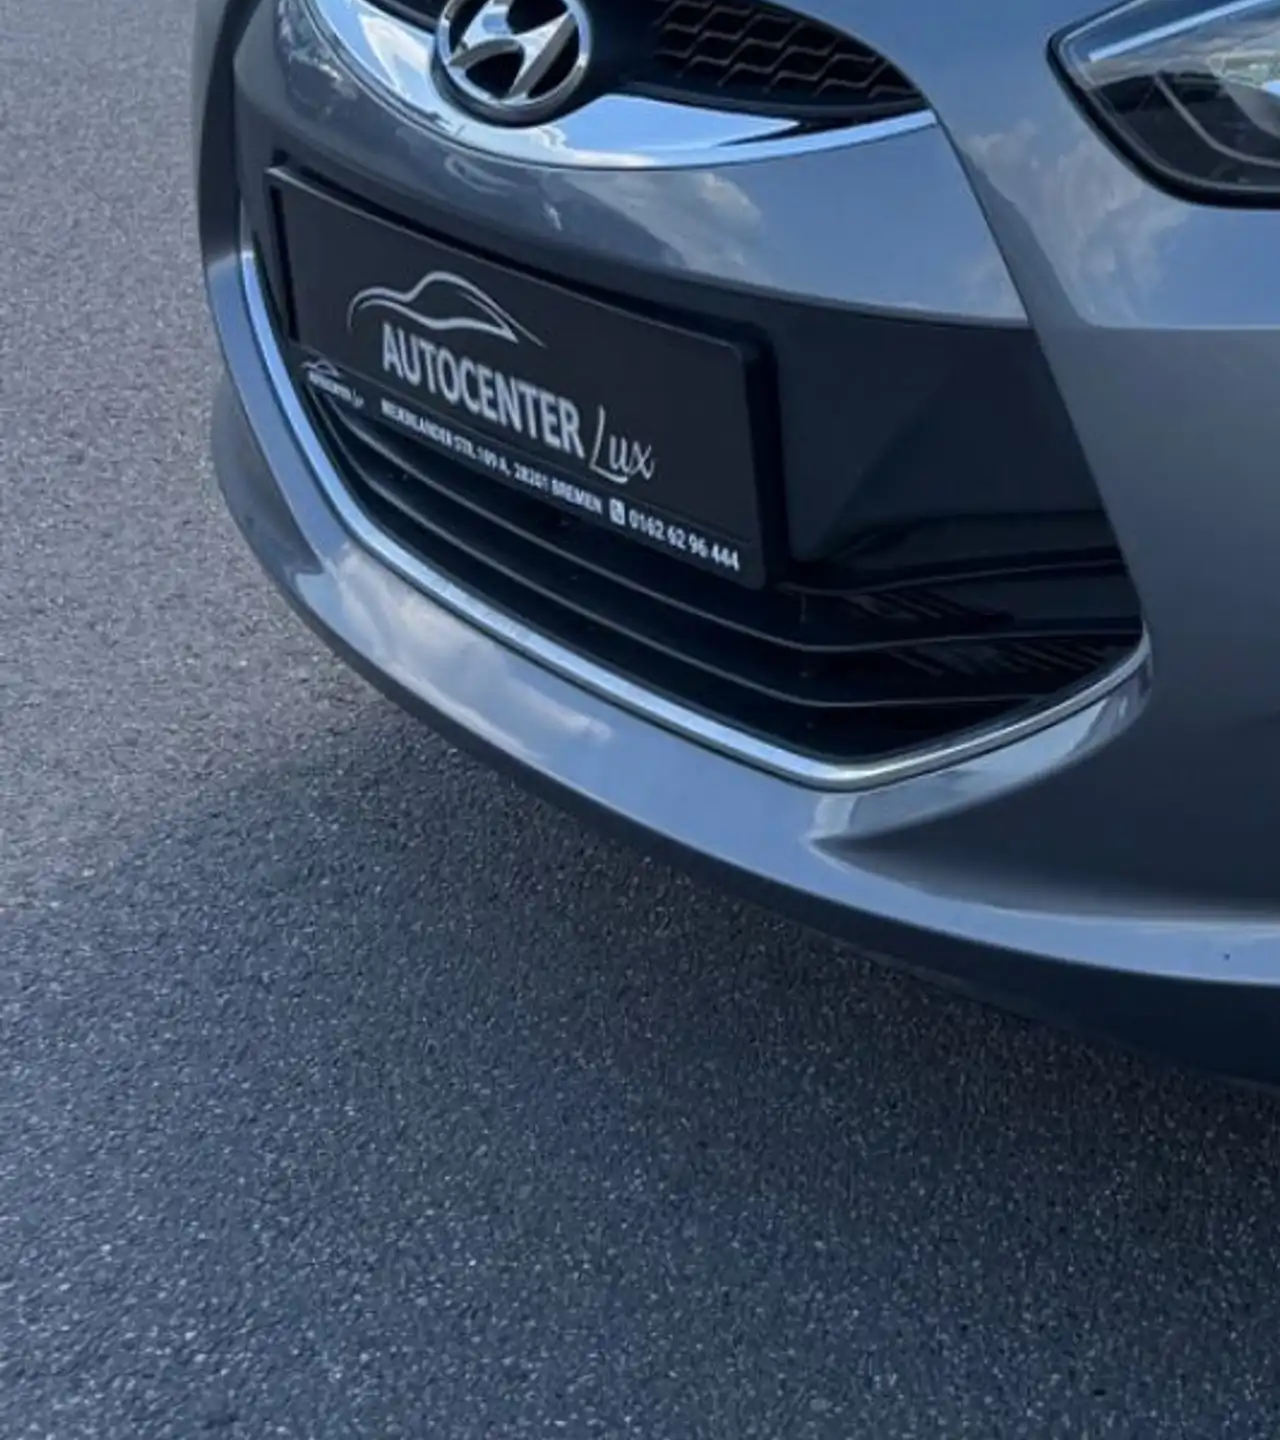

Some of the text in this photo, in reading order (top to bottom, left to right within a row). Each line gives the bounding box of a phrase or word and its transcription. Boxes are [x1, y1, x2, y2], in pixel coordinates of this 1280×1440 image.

[383, 322, 585, 459] AUTOCENTER
[588, 404, 655, 485] Lux
[628, 509, 666, 542] 0162
[666, 524, 687, 550] 62
[688, 533, 709, 558] 96
